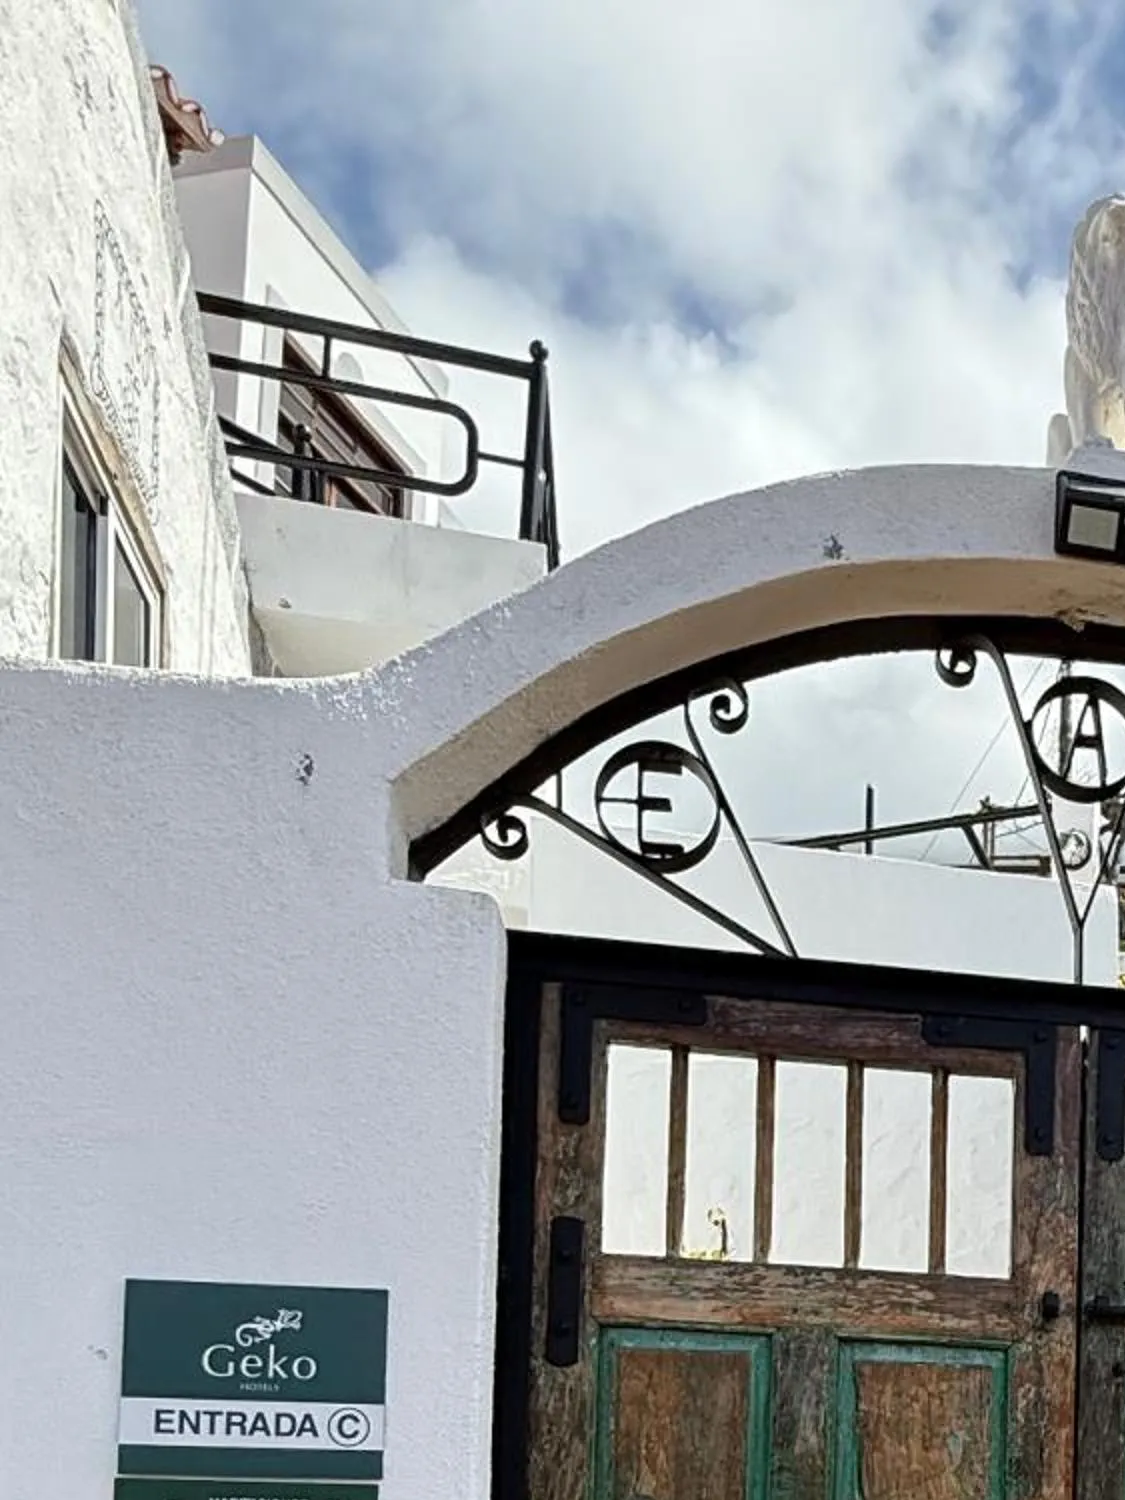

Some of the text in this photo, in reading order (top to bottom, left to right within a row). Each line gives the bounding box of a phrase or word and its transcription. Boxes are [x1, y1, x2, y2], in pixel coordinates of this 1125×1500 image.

[1062, 688, 1108, 791] A
[202, 1343, 317, 1380] Geko
[154, 1409, 319, 1438] ENTRADA
